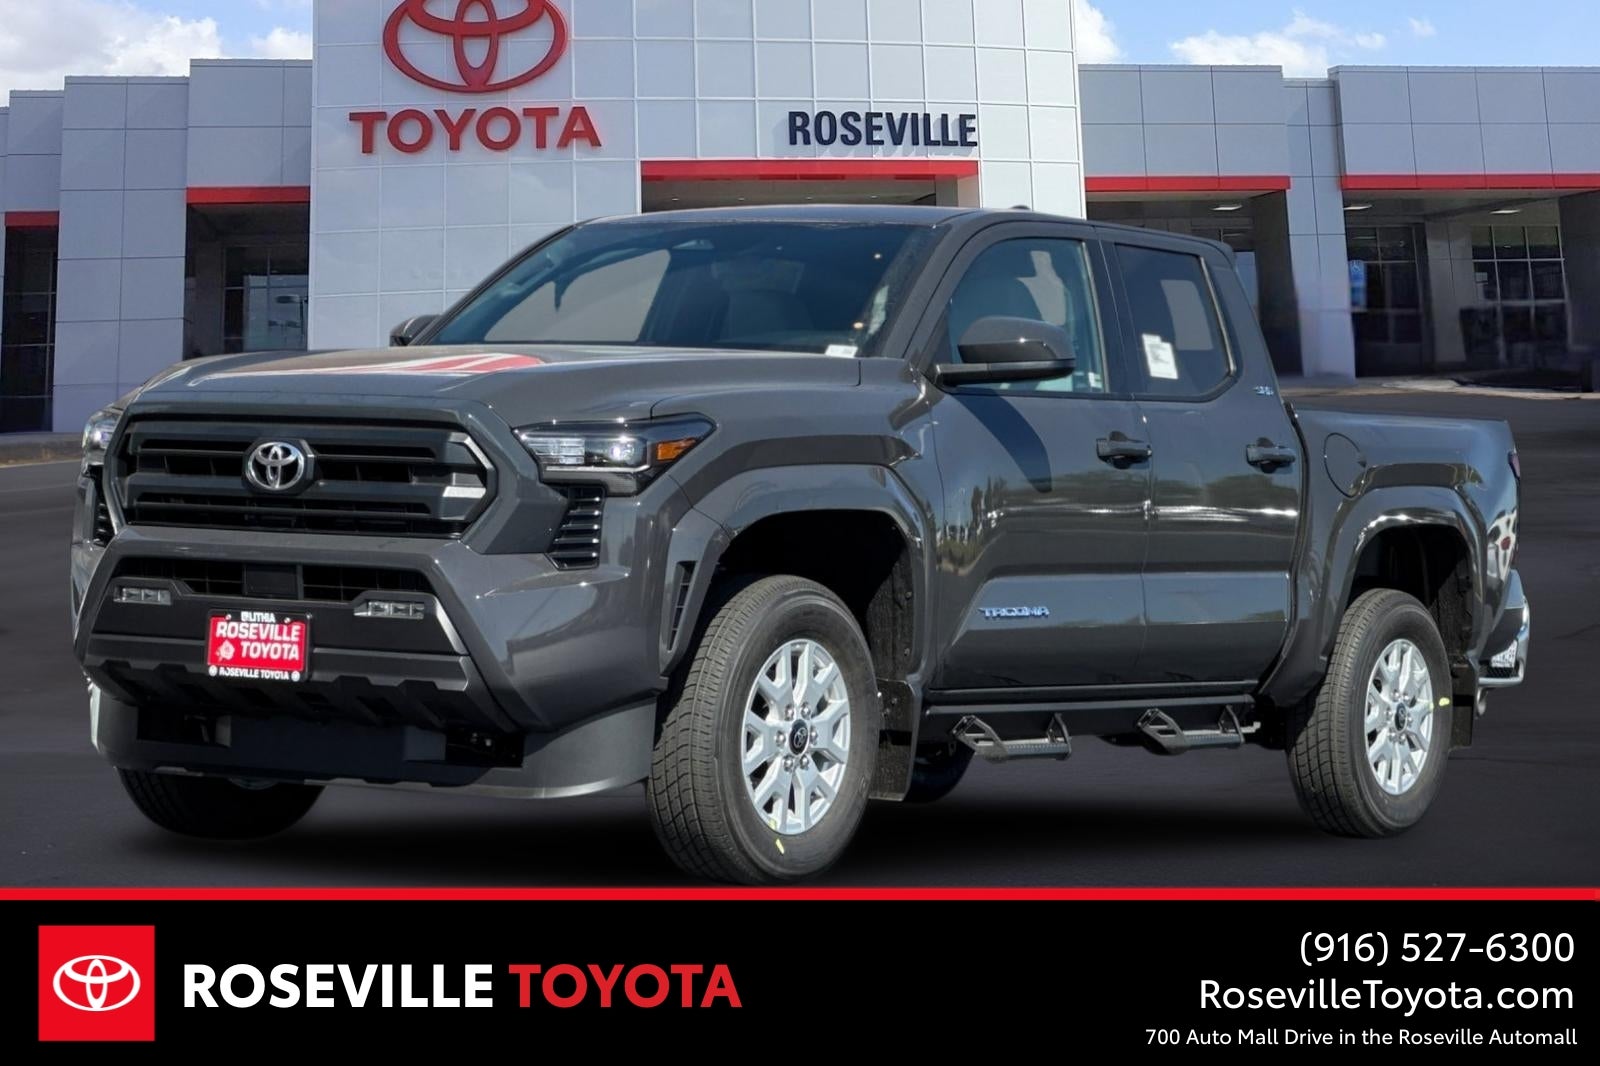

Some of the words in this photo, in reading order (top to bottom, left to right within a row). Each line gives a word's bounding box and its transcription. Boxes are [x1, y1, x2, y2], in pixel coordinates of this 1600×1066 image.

[348, 106, 602, 154] TOYOTA
[788, 110, 979, 148] ROSEVILLE
[979, 606, 1050, 619] TACOMA
[215, 621, 300, 641] ROSEVILLE
[240, 641, 299, 660] TOYOTA
[219, 666, 259, 678] ROSEVILLE
[261, 669, 289, 680] TOYOTA
